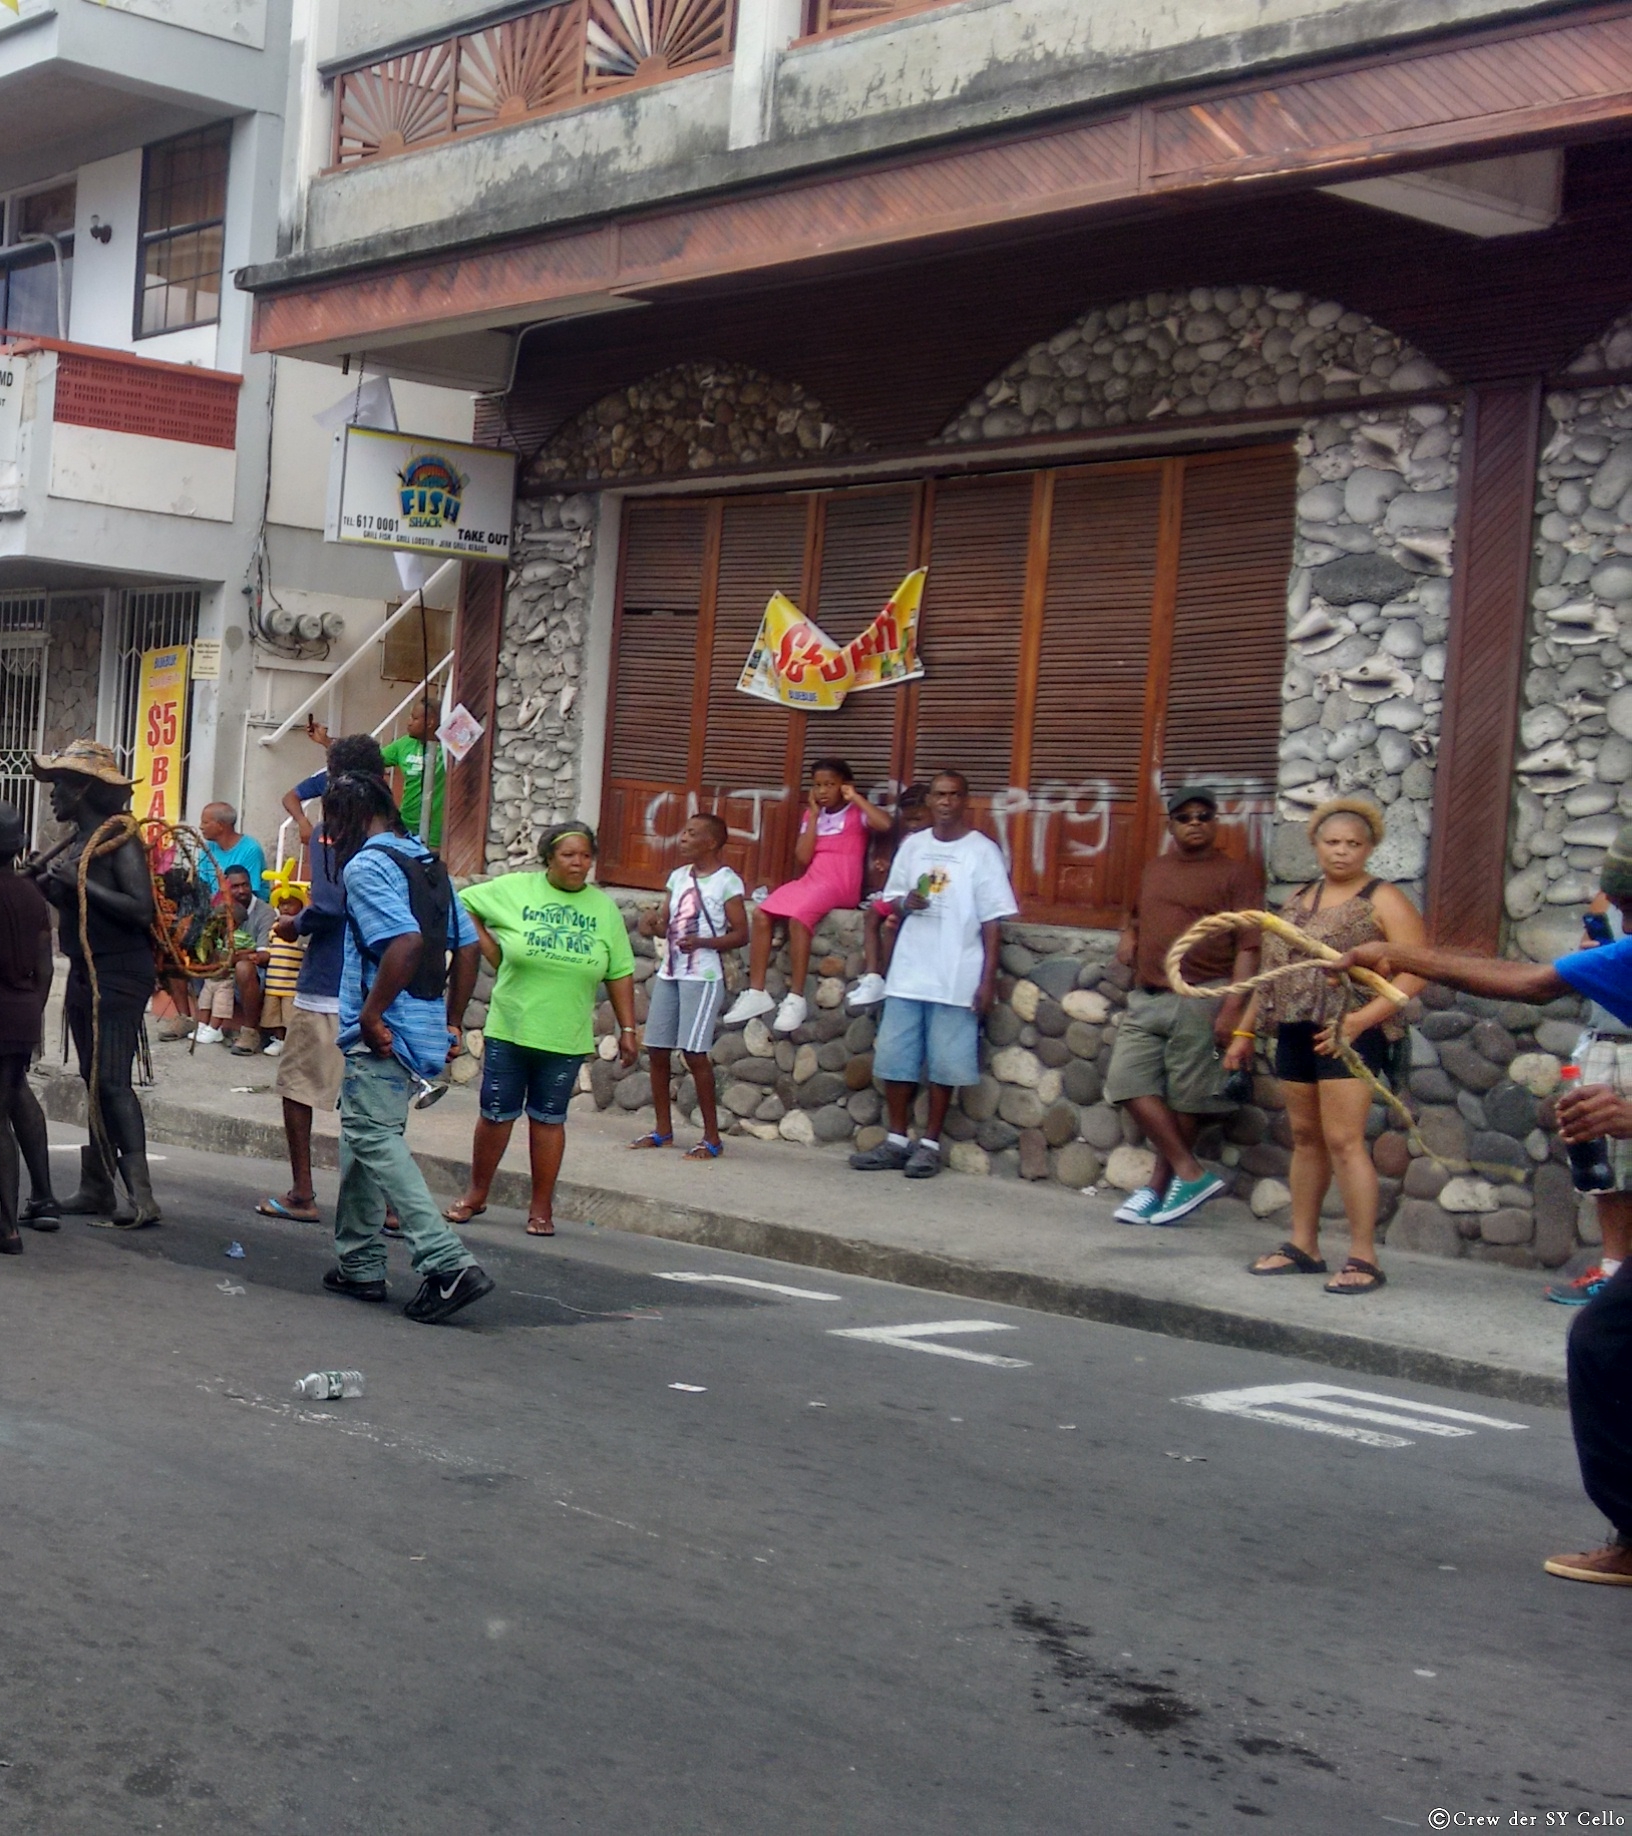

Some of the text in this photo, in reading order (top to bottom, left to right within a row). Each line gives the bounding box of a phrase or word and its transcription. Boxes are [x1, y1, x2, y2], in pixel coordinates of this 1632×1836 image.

[400, 489, 462, 526] FISH
[356, 514, 374, 529] 617
[377, 517, 400, 532] 0001
[409, 516, 443, 528] SHACK
[458, 528, 509, 546] TAKE OUT
[147, 700, 178, 752] $5
[522, 905, 597, 932] Carnival 2014
